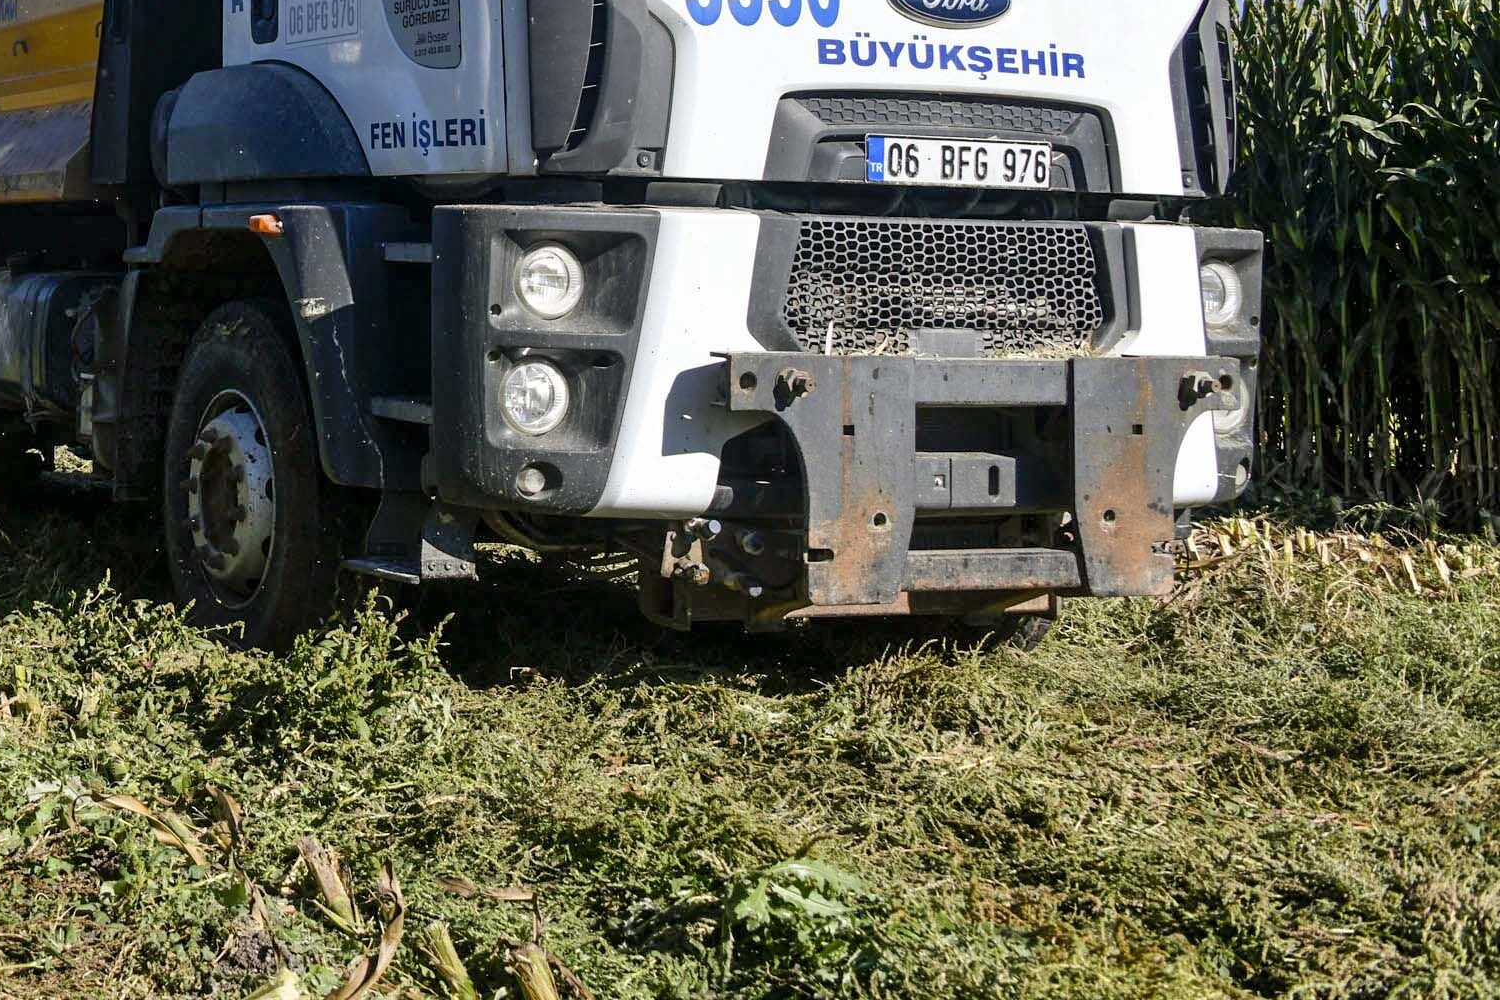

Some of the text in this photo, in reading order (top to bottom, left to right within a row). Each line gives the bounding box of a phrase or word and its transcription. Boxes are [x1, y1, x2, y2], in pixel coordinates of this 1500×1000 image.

[289, 5, 303, 36] 06
[307, 0, 328, 33] BFG
[817, 32, 1086, 81] BÜYÜKŞEHİR
[370, 109, 486, 156] FEN İŞLERİ
[870, 137, 1047, 184] TR 06 BFG 976
